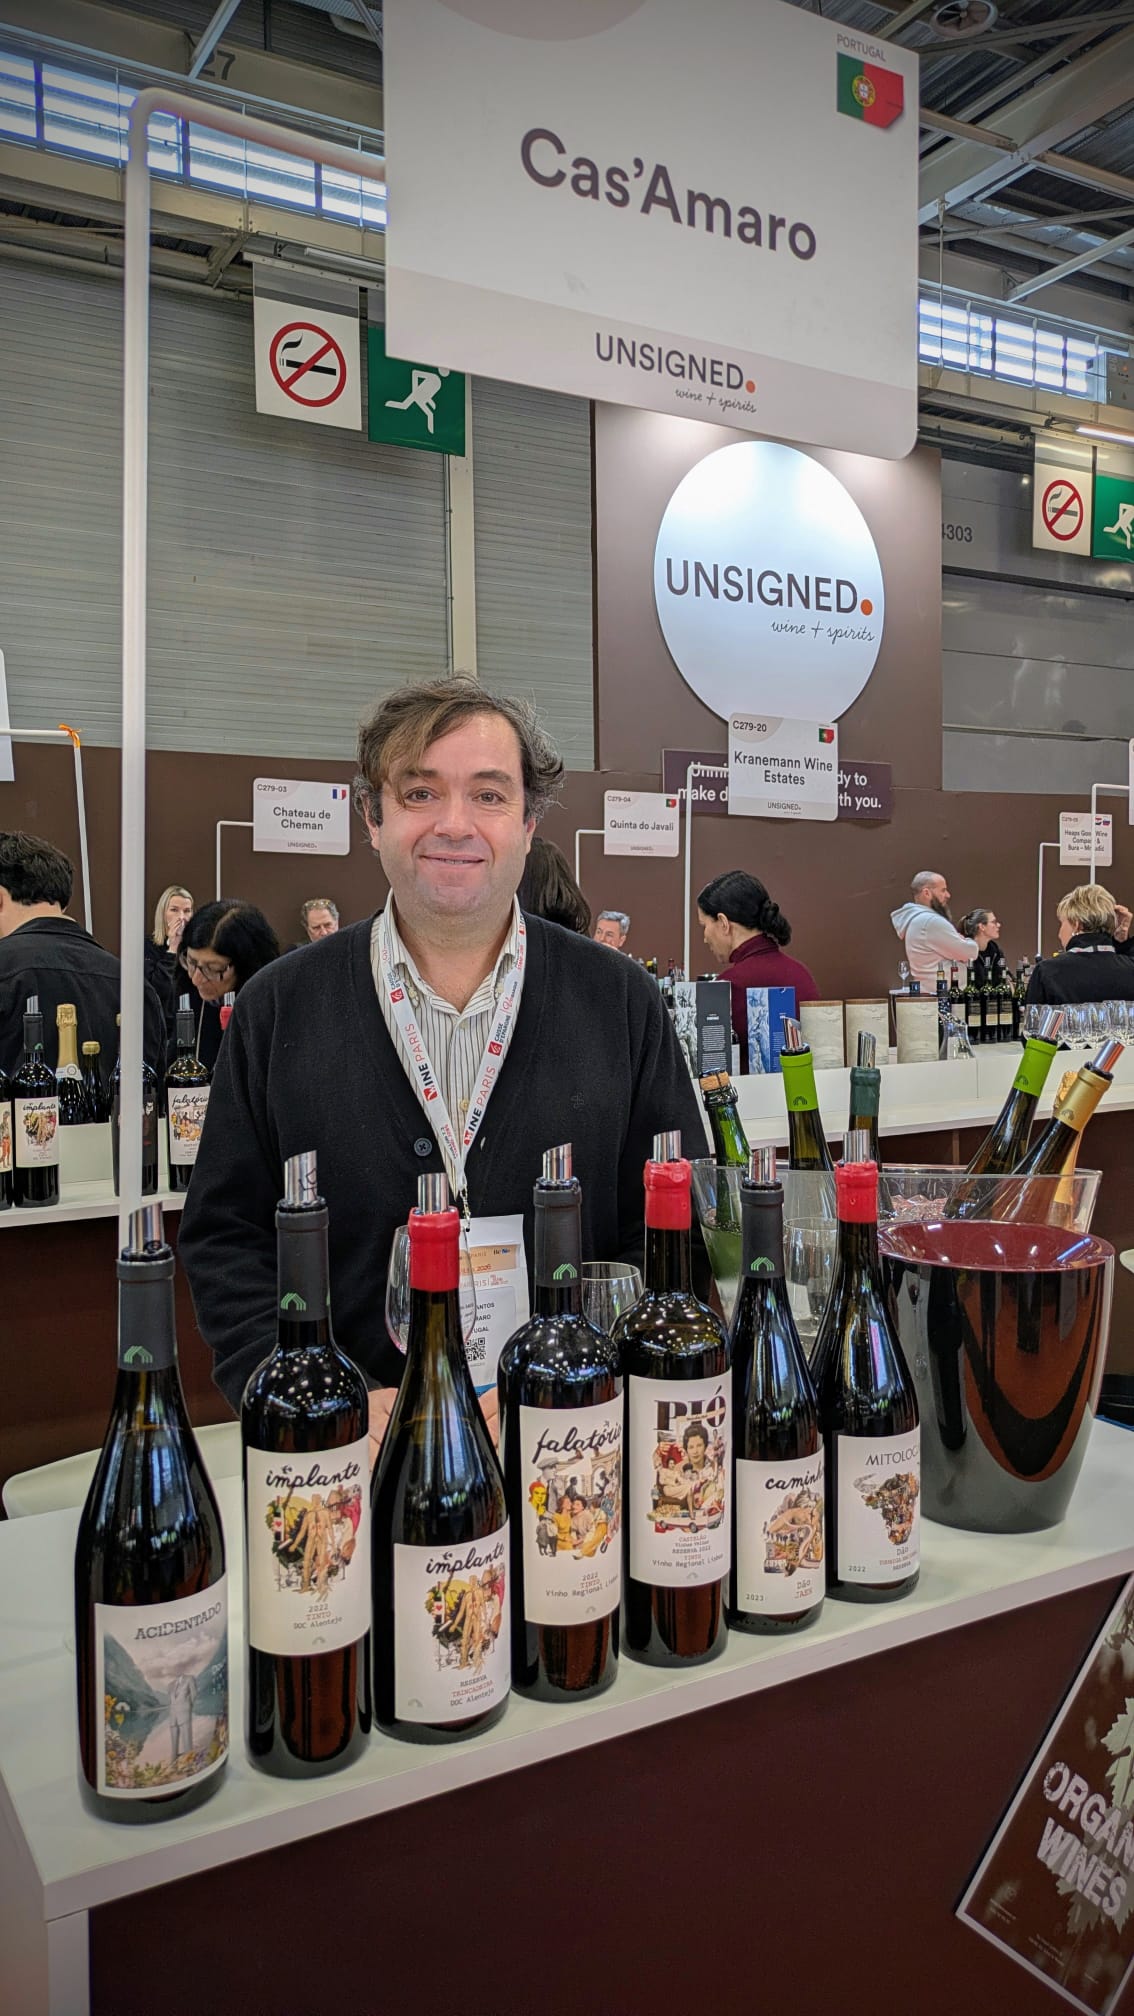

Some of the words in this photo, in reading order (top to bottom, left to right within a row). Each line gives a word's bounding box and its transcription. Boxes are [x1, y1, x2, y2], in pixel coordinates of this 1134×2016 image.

[837, 33, 887, 62] PORTUGAL
[674, 388, 703, 403] wine
[718, 396, 757, 415] spirits
[771, 618, 806, 635] wine
[826, 623, 875, 645] spirits
[732, 720, 767, 733] C279-20
[734, 750, 801, 769] Kranemann
[803, 756, 833, 772] Wine
[764, 769, 806, 786] Estates
[854, 772, 868, 786] to
[256, 783, 288, 793] C279-03
[854, 796, 882, 811] you.
[272, 806, 316, 819] Chateau
[318, 809, 331, 820] de
[280, 818, 324, 831] Cheman
[609, 819, 638, 830] Quinta
[639, 820, 650, 830] do
[651, 821, 674, 831] Javali
[404, 1023, 424, 1063] PARIS
[475, 1066, 497, 1108] PARIS
[265, 1461, 361, 1489] implante
[652, 1559, 673, 1568] Vinho
[675, 1558, 705, 1569] Regional
[545, 1589, 569, 1597] Vinho
[572, 1584, 603, 1597] Regional
[134, 1602, 222, 1641] ACIDENTADO
[293, 1622, 307, 1630] DOC
[310, 1616, 343, 1628] Alentejo
[306, 1610, 332, 1621] TINTO
[450, 1699, 463, 1707] DOC
[466, 1688, 495, 1704] Alentejo
[1036, 1817, 1127, 1917] WINES
